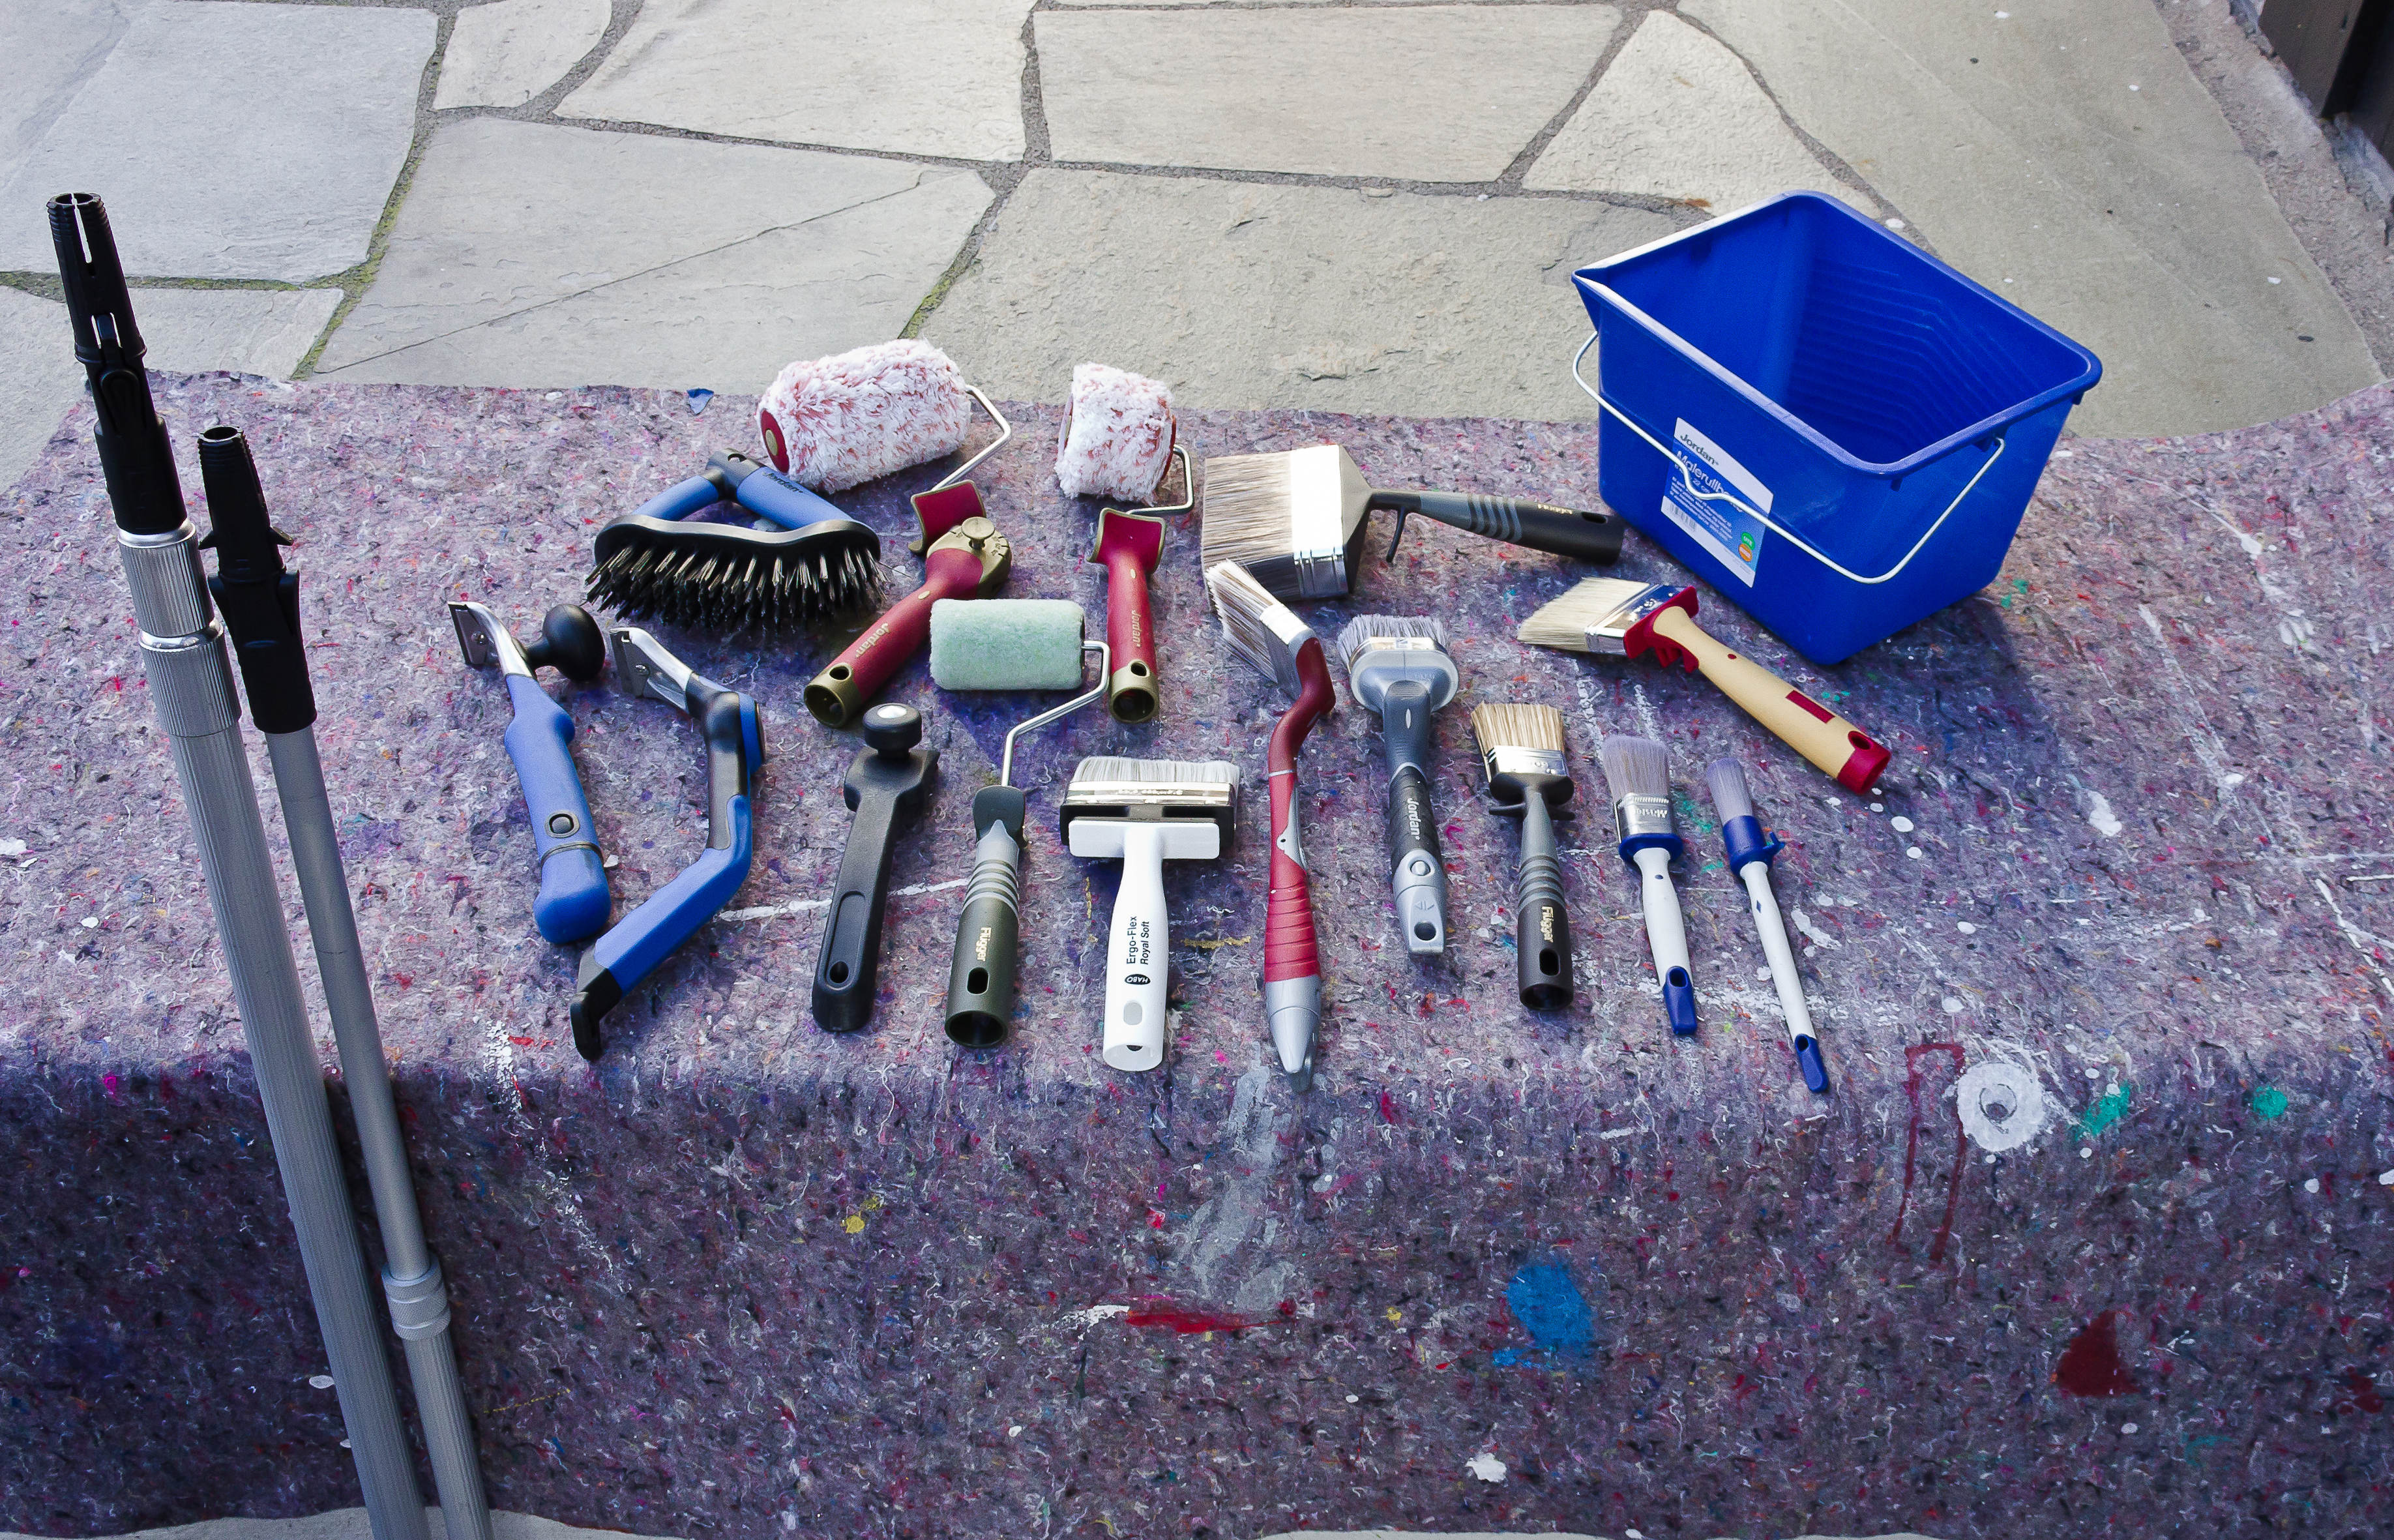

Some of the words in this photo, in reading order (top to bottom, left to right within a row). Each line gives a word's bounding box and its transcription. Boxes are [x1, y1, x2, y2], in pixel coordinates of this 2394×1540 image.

[1680, 434, 1716, 465] Jordan
[855, 623, 890, 655] Jordan
[1132, 610, 1142, 643] Jordan
[1407, 798, 1421, 836] Jordan
[1127, 916, 1138, 964] Ergo-Flex
[1140, 921, 1149, 938] Soft
[1140, 940, 1150, 965] Royal
